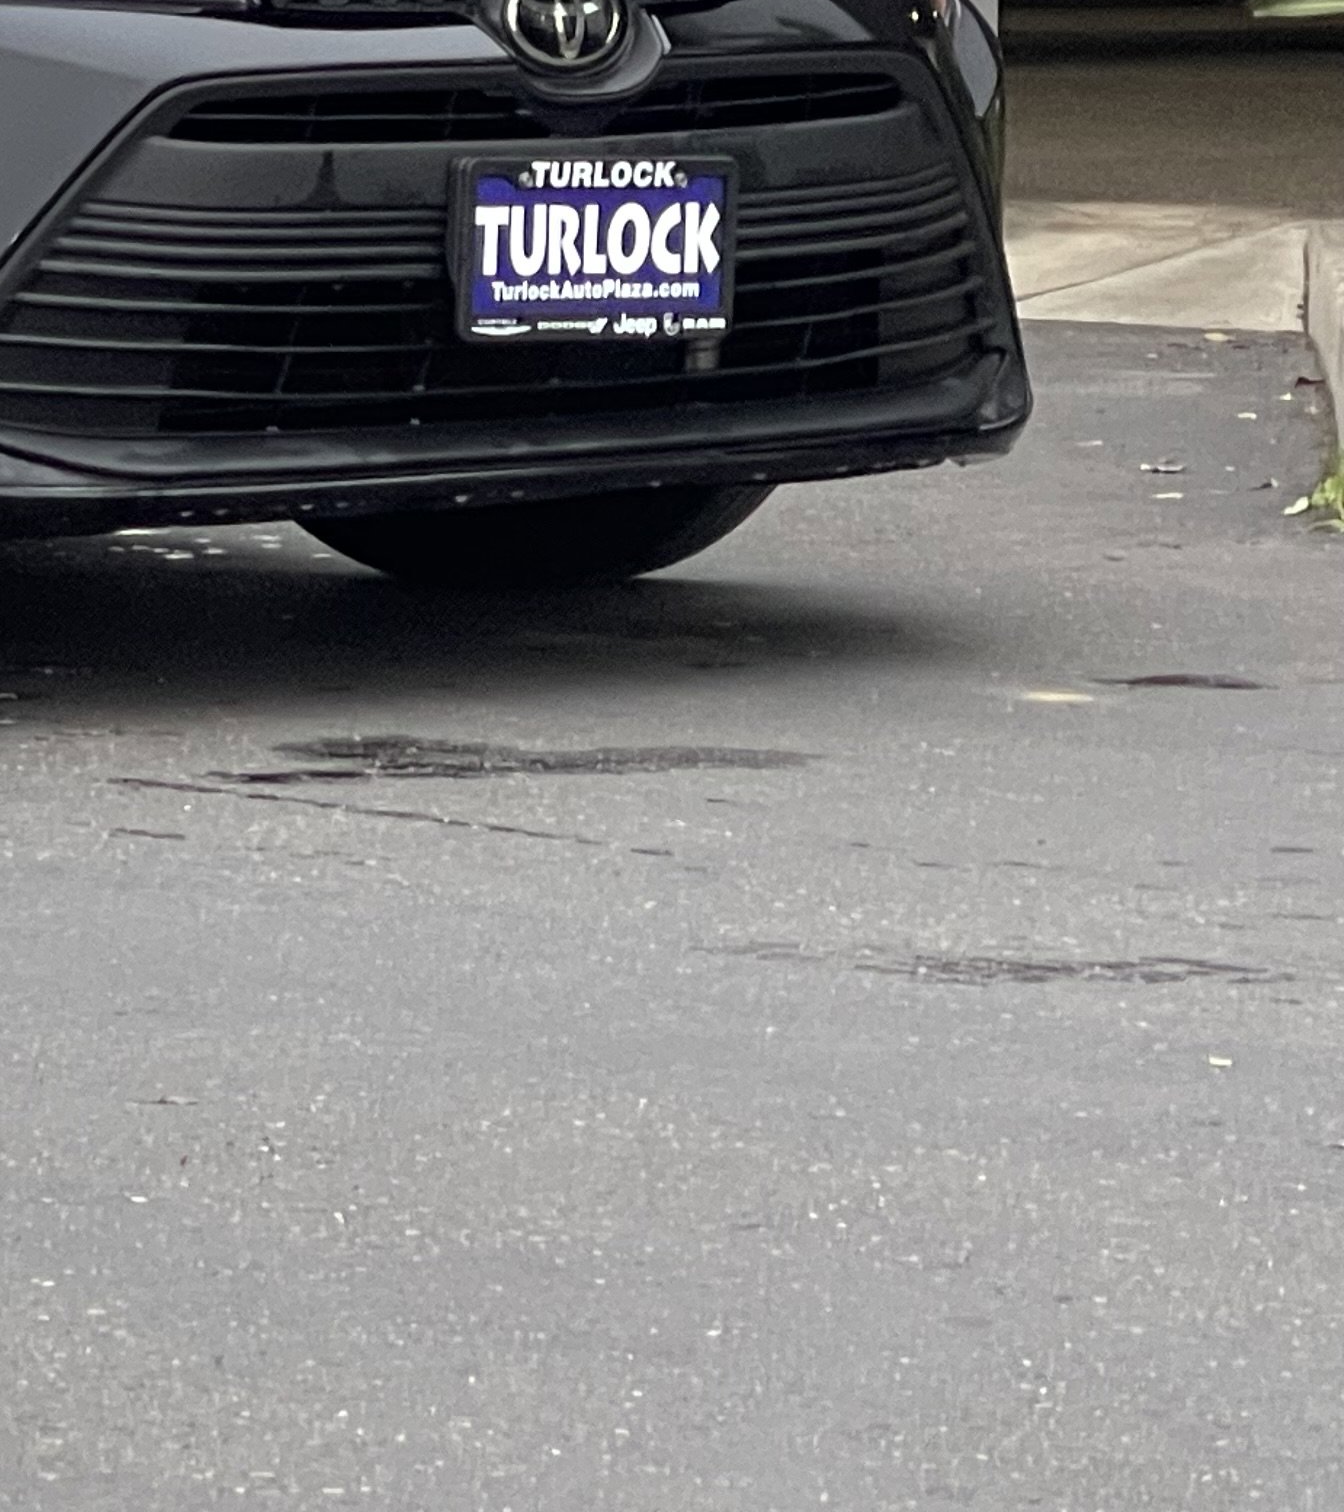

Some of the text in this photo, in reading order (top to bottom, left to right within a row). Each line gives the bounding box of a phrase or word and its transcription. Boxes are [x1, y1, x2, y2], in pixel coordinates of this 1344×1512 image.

[531, 161, 676, 188] TURLOCK
[475, 201, 721, 277] TURLOCK
[491, 279, 701, 302] TurlockAutoPlaza.com
[613, 312, 658, 338] Jeep
